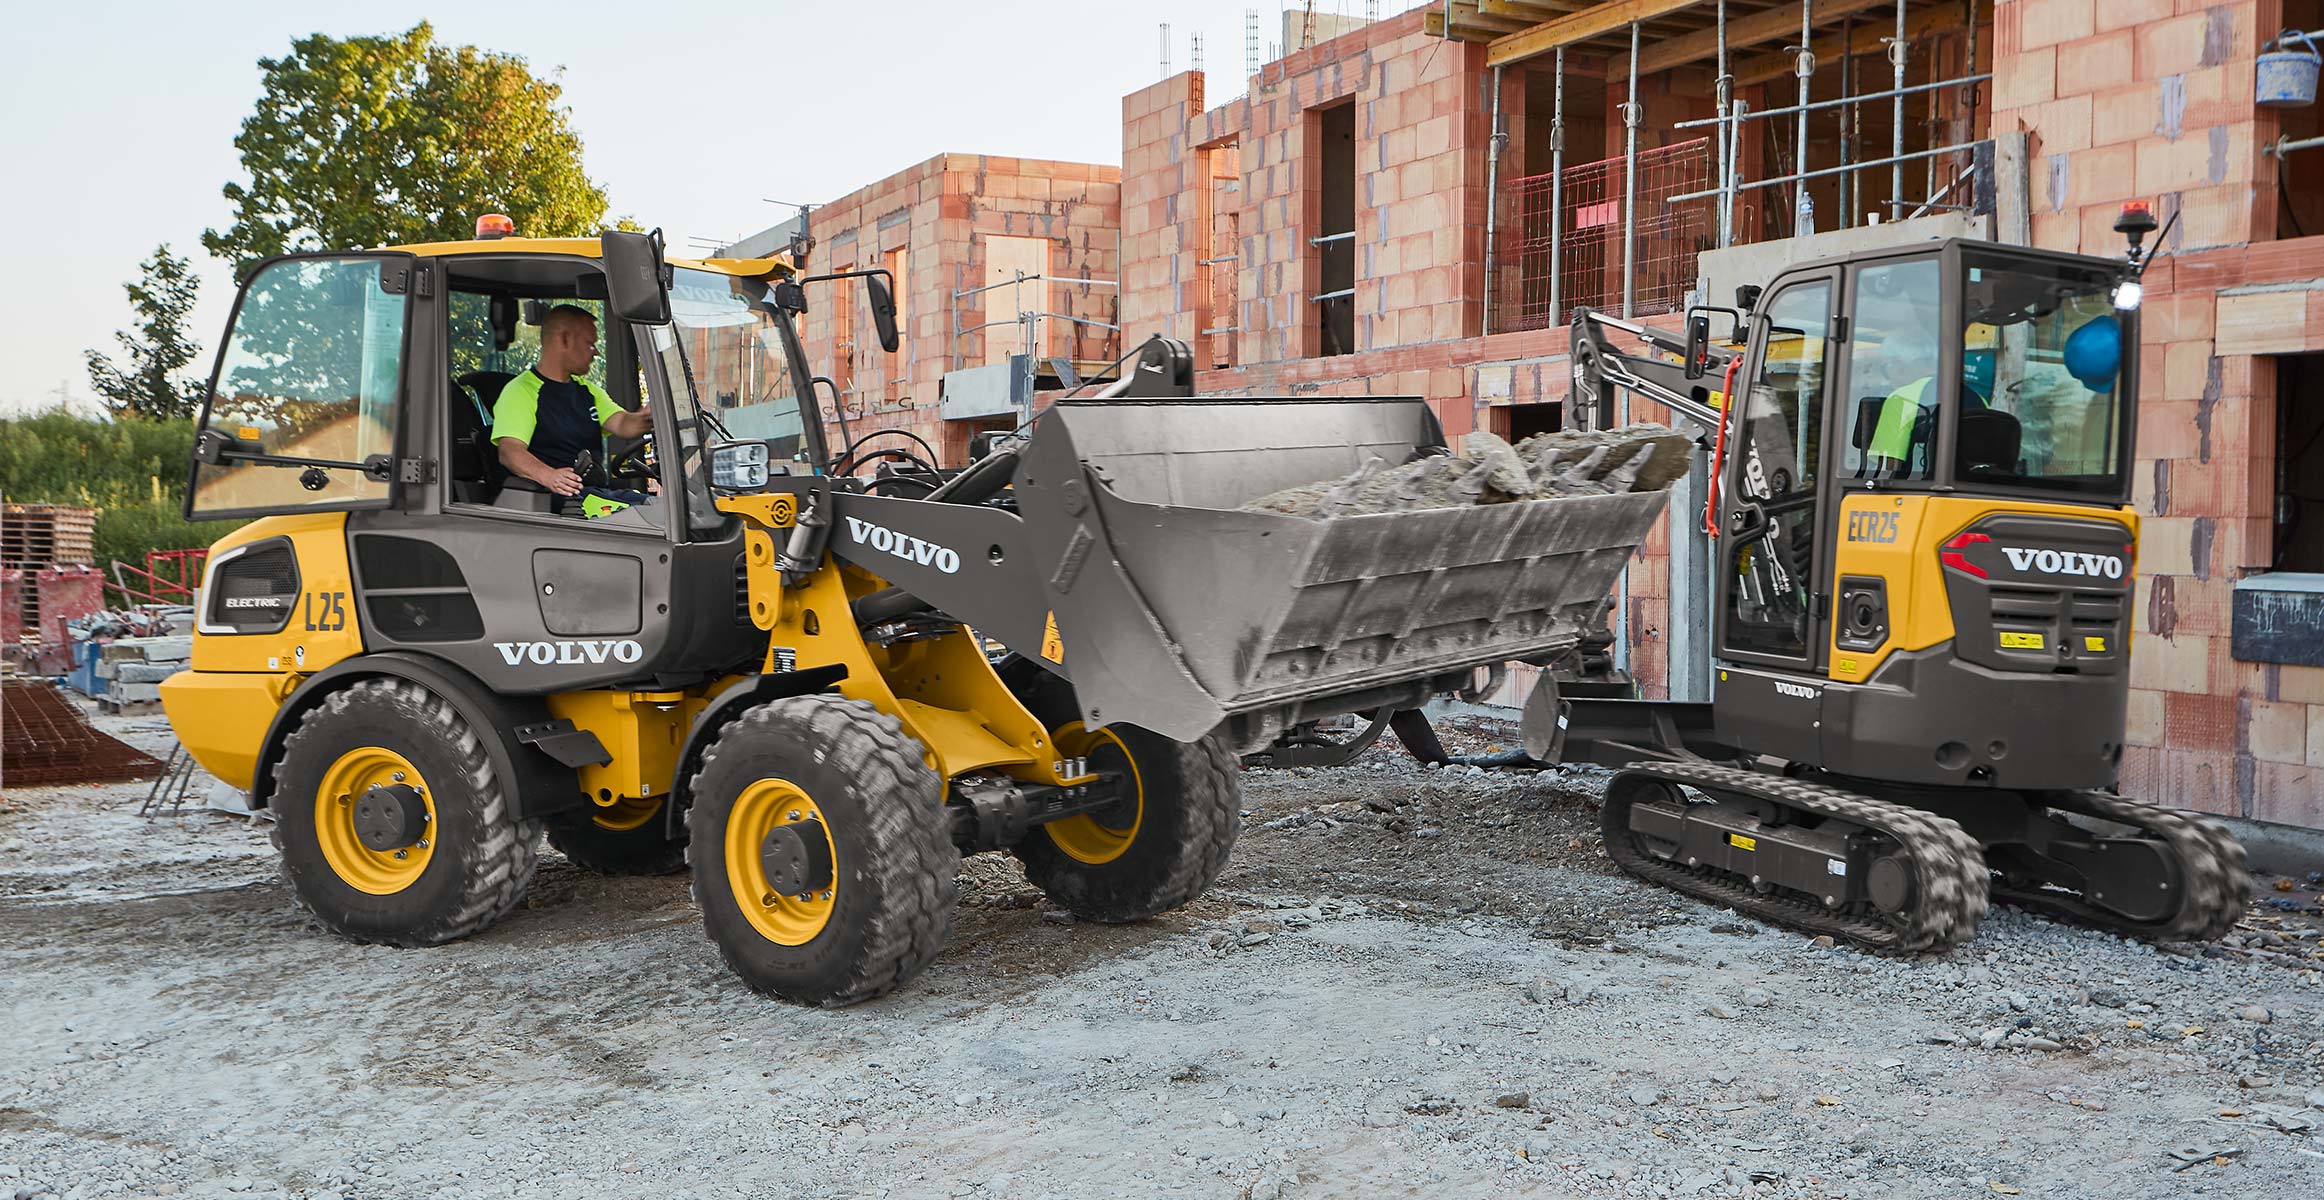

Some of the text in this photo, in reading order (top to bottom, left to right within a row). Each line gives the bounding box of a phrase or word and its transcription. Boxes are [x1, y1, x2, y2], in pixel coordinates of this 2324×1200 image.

[1848, 510, 1898, 545] ECR25
[845, 515, 960, 574] VOLVO
[2001, 547, 2123, 580] VOLVO
[225, 597, 281, 608] ELECTRIC
[305, 592, 345, 632] L25
[493, 640, 643, 666] VOLVO
[1774, 681, 1815, 699] VOLVO
